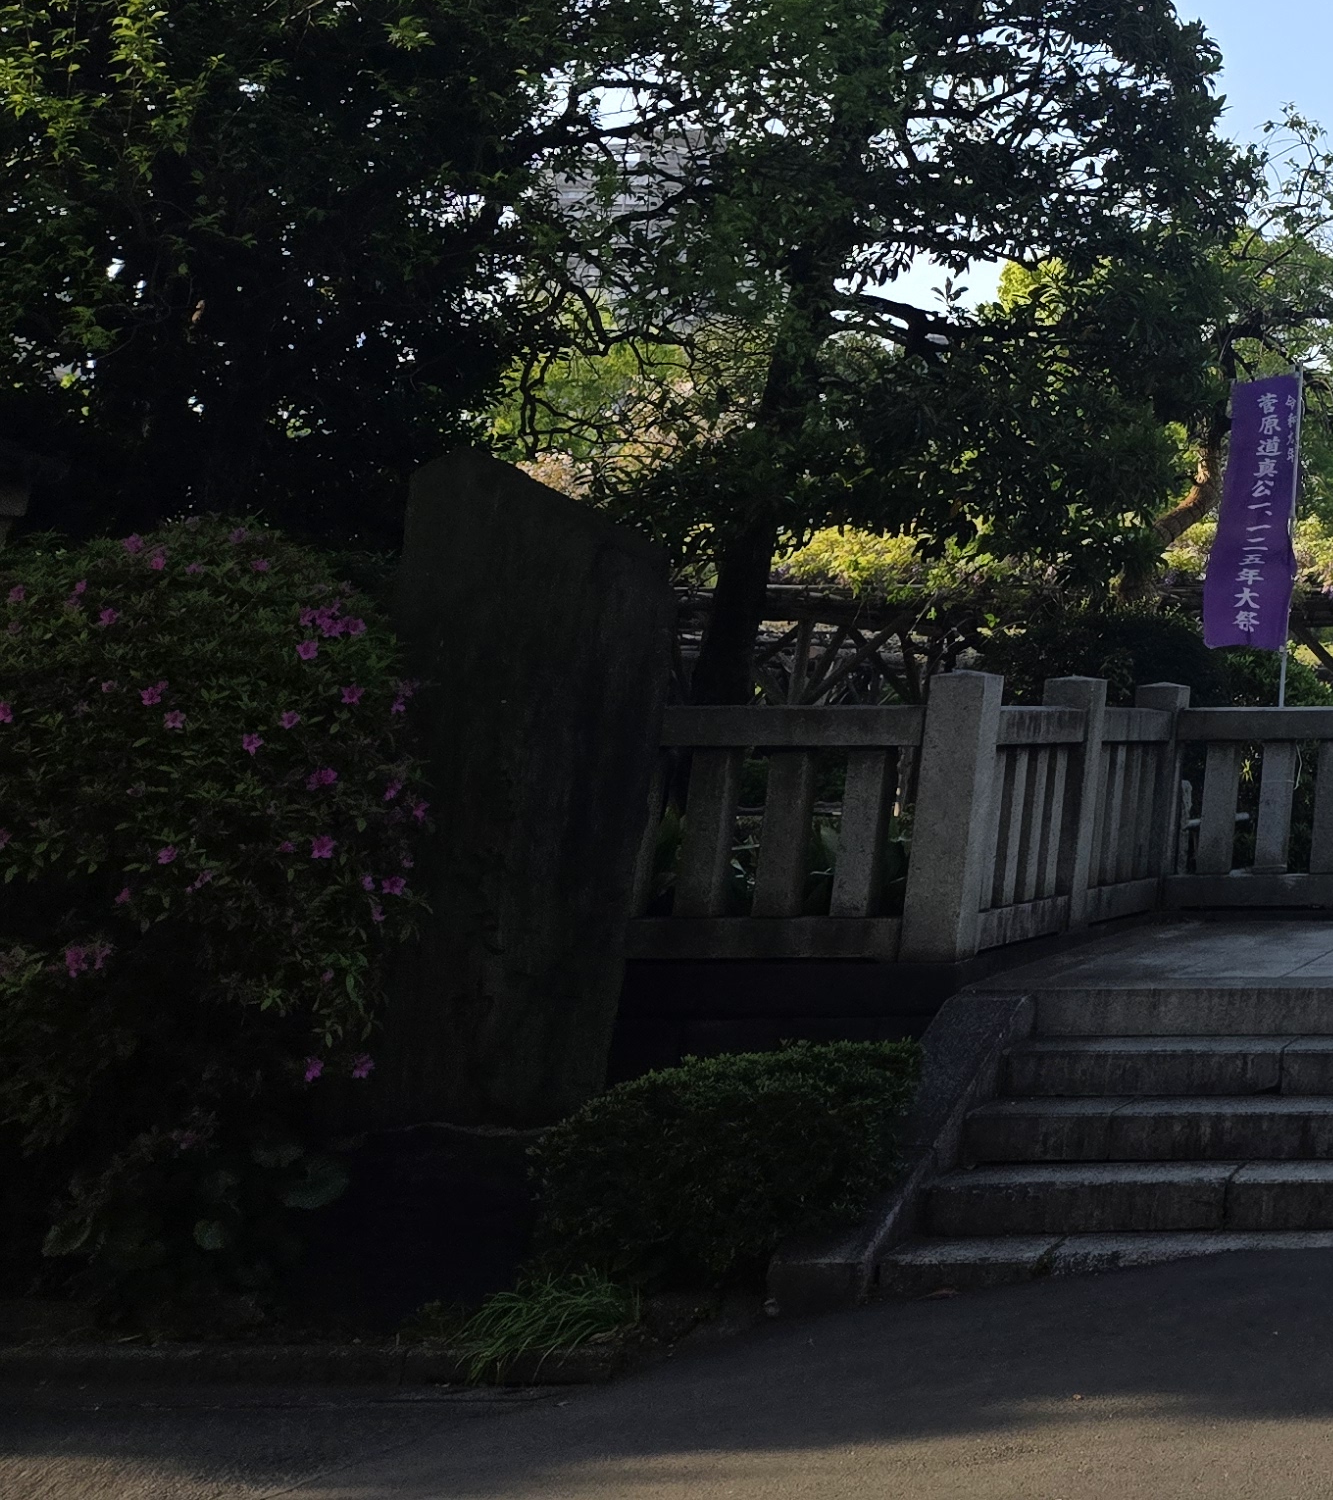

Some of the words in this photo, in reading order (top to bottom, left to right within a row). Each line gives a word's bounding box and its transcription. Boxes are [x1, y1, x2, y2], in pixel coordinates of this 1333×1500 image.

[1233, 393, 1281, 632] 菅原道真公一、一二五年大祭
